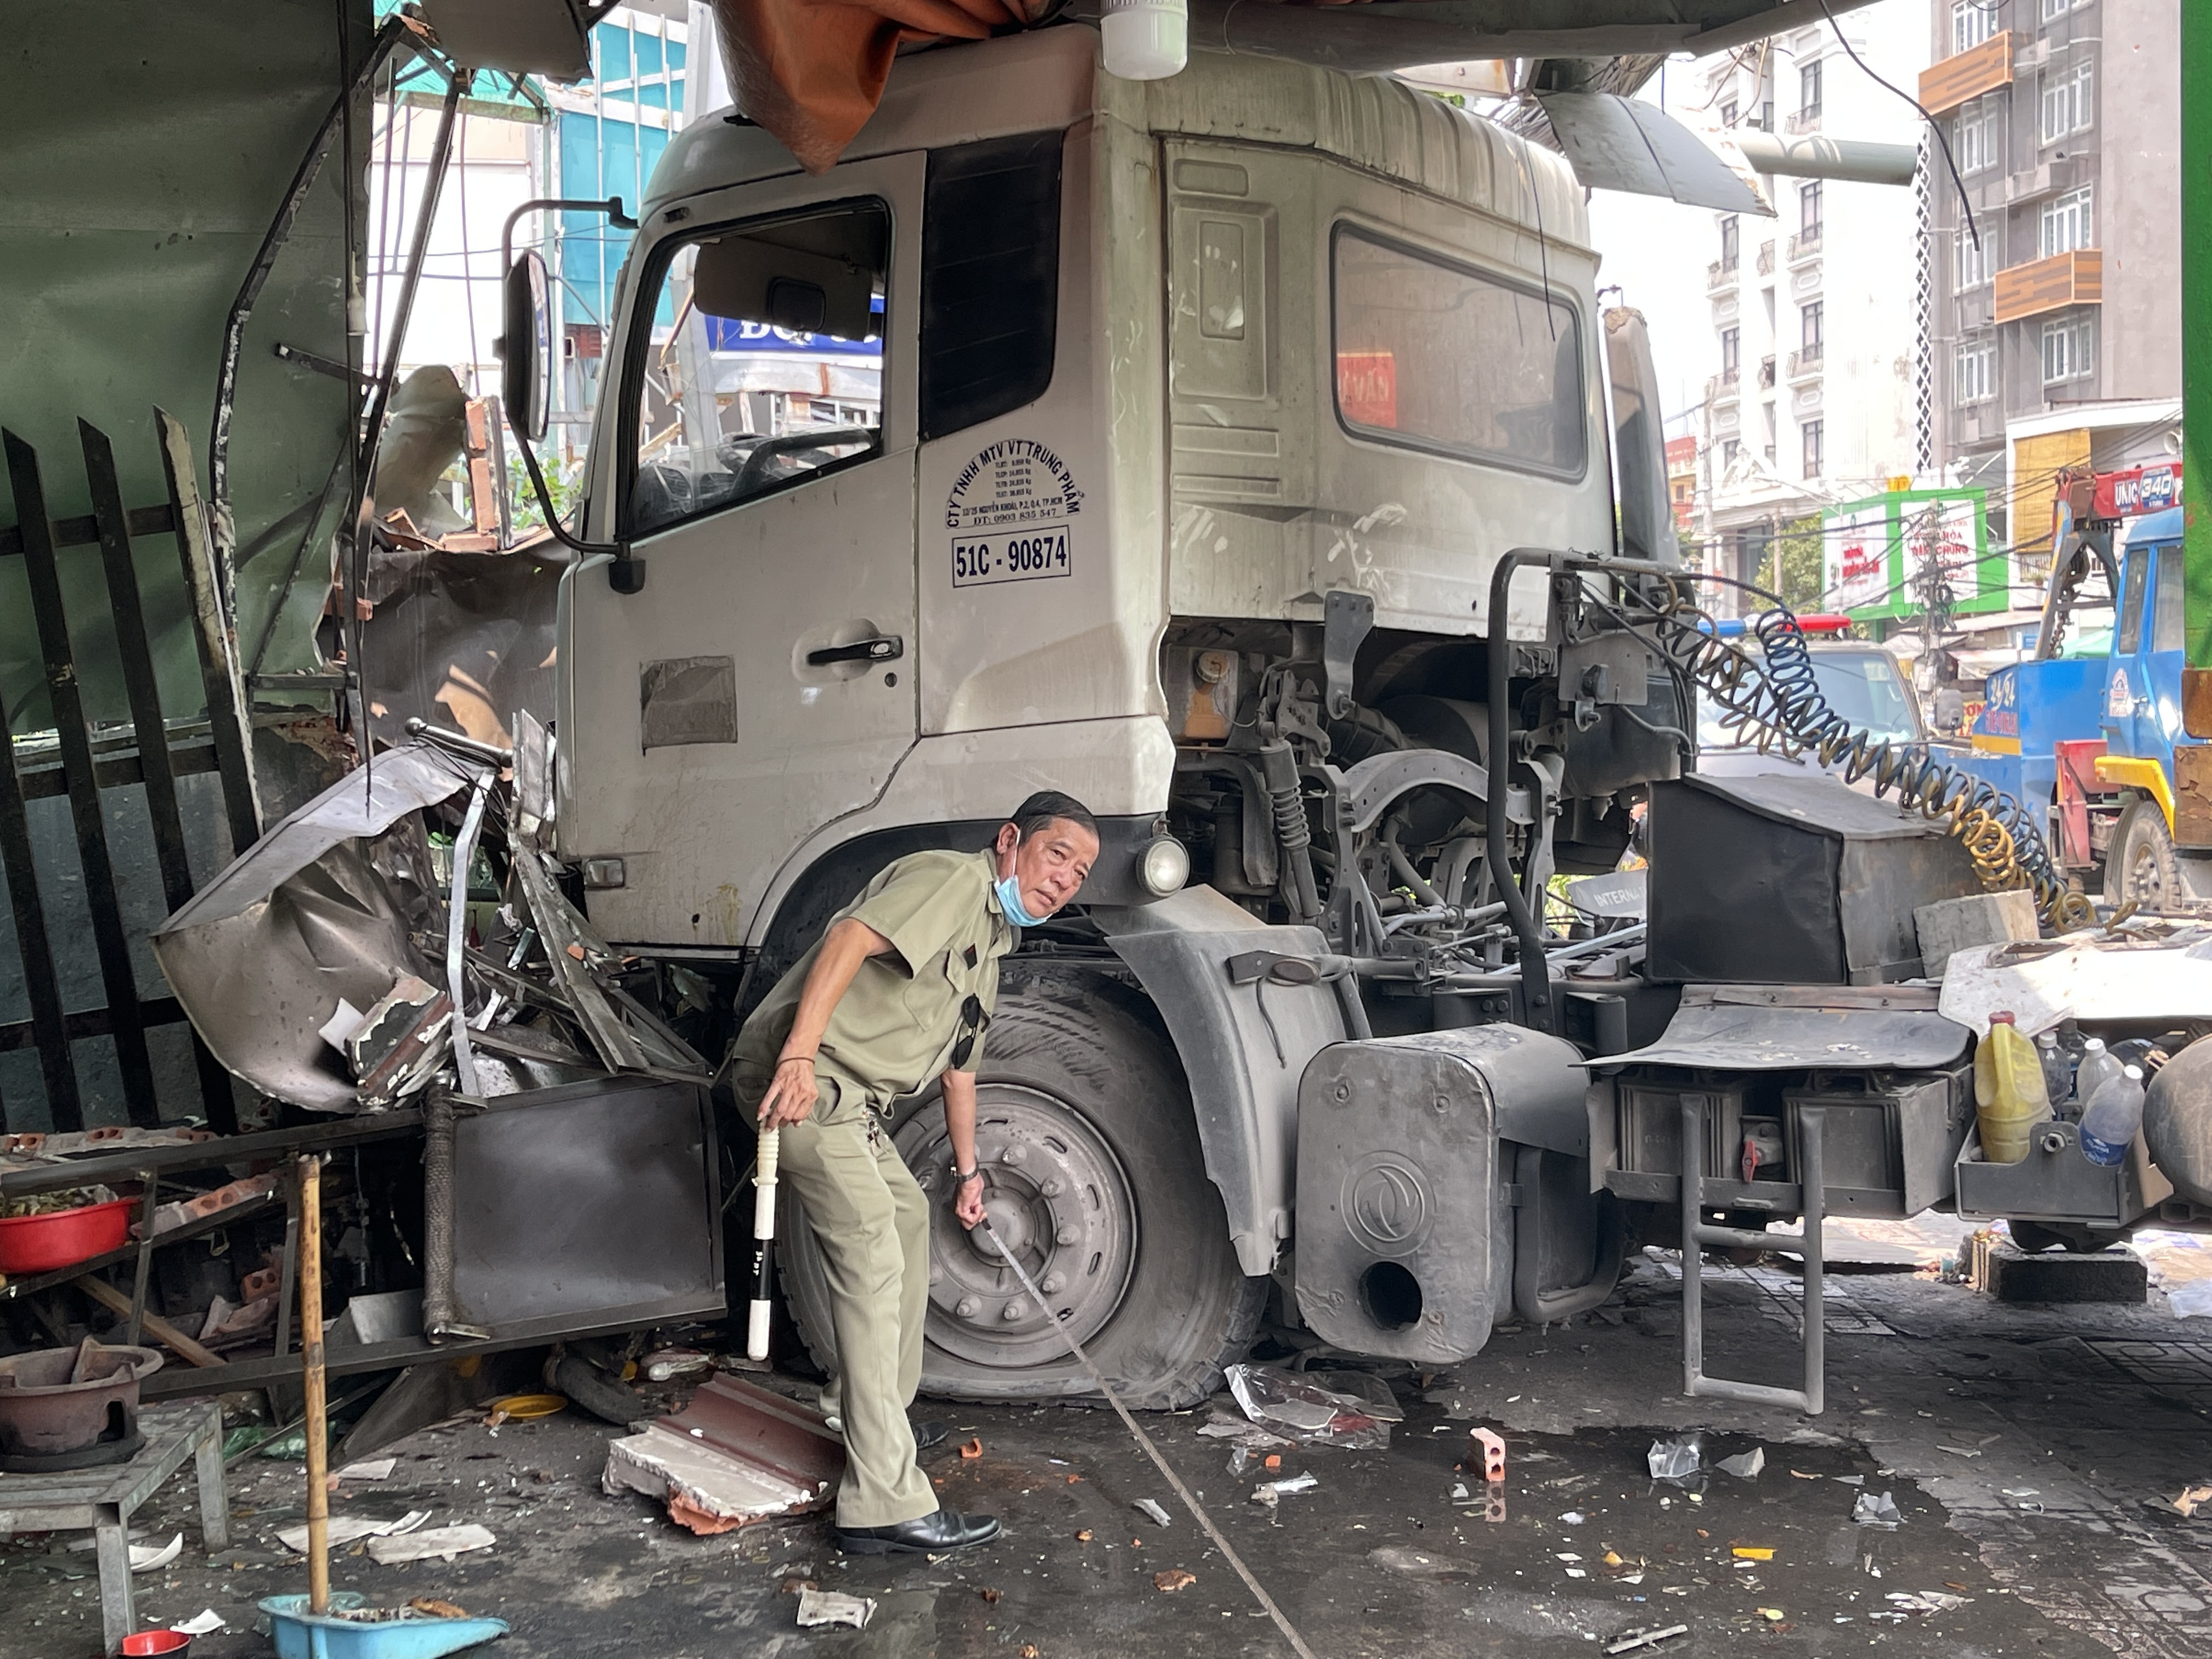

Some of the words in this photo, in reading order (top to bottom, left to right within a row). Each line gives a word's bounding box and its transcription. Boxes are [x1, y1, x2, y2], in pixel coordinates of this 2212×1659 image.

[980, 442, 1003, 466] MTV
[1008, 440, 1022, 455] VT
[1028, 442, 1062, 476] TRUNG
[953, 464, 980, 496] TNHH
[2141, 474, 2172, 498] 340
[2115, 481, 2138, 506] UNIC
[947, 500, 961, 527] CTY
[956, 544, 989, 577] 51C
[1008, 535, 1066, 572] 90874
